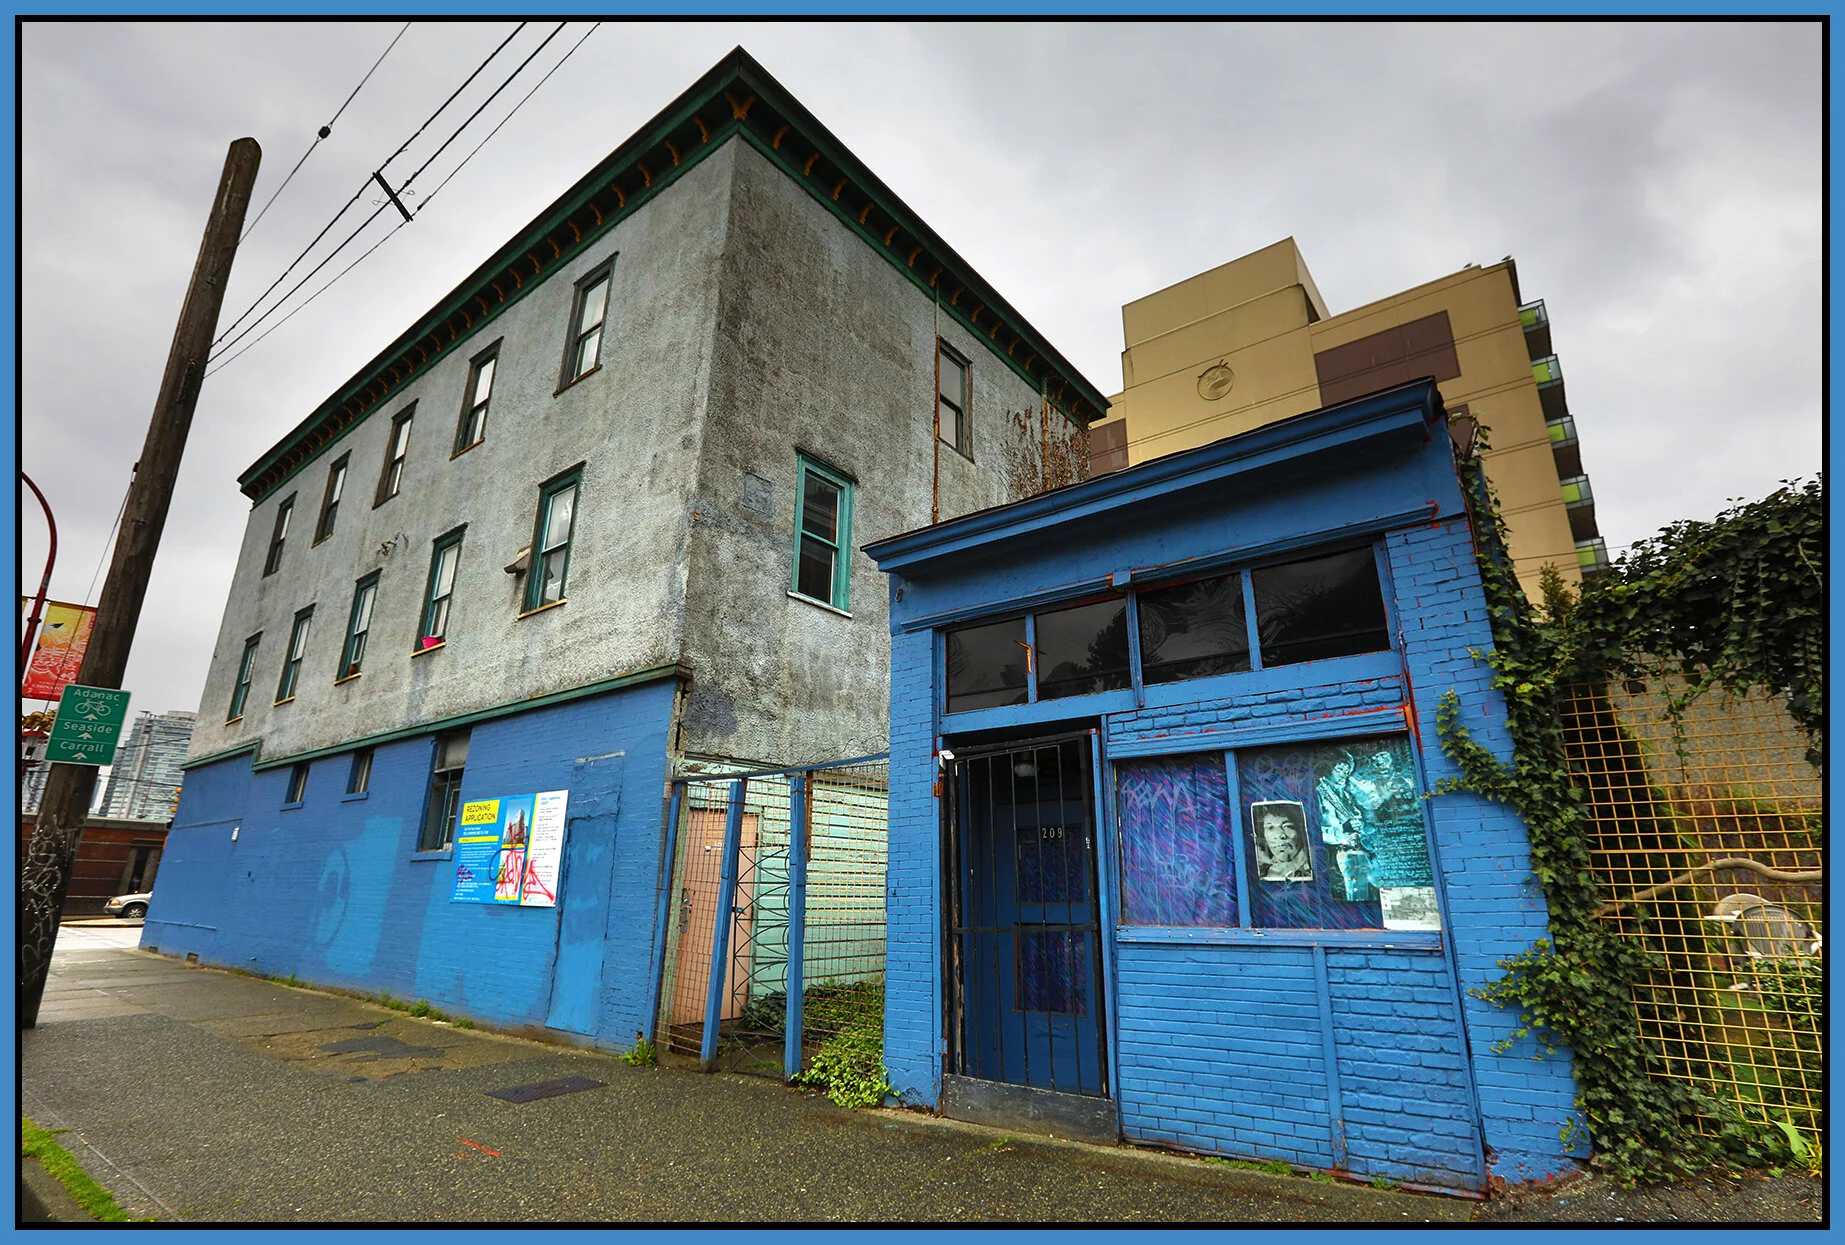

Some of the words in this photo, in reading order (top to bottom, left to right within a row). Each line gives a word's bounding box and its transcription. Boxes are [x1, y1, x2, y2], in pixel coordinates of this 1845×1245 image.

[73, 688, 120, 701] Adanac
[63, 721, 113, 734] Seaside
[60, 741, 104, 753] Carrall
[466, 803, 491, 813] REZONING
[465, 812, 496, 822] APPLICATION
[1041, 827, 1063, 839] 209
